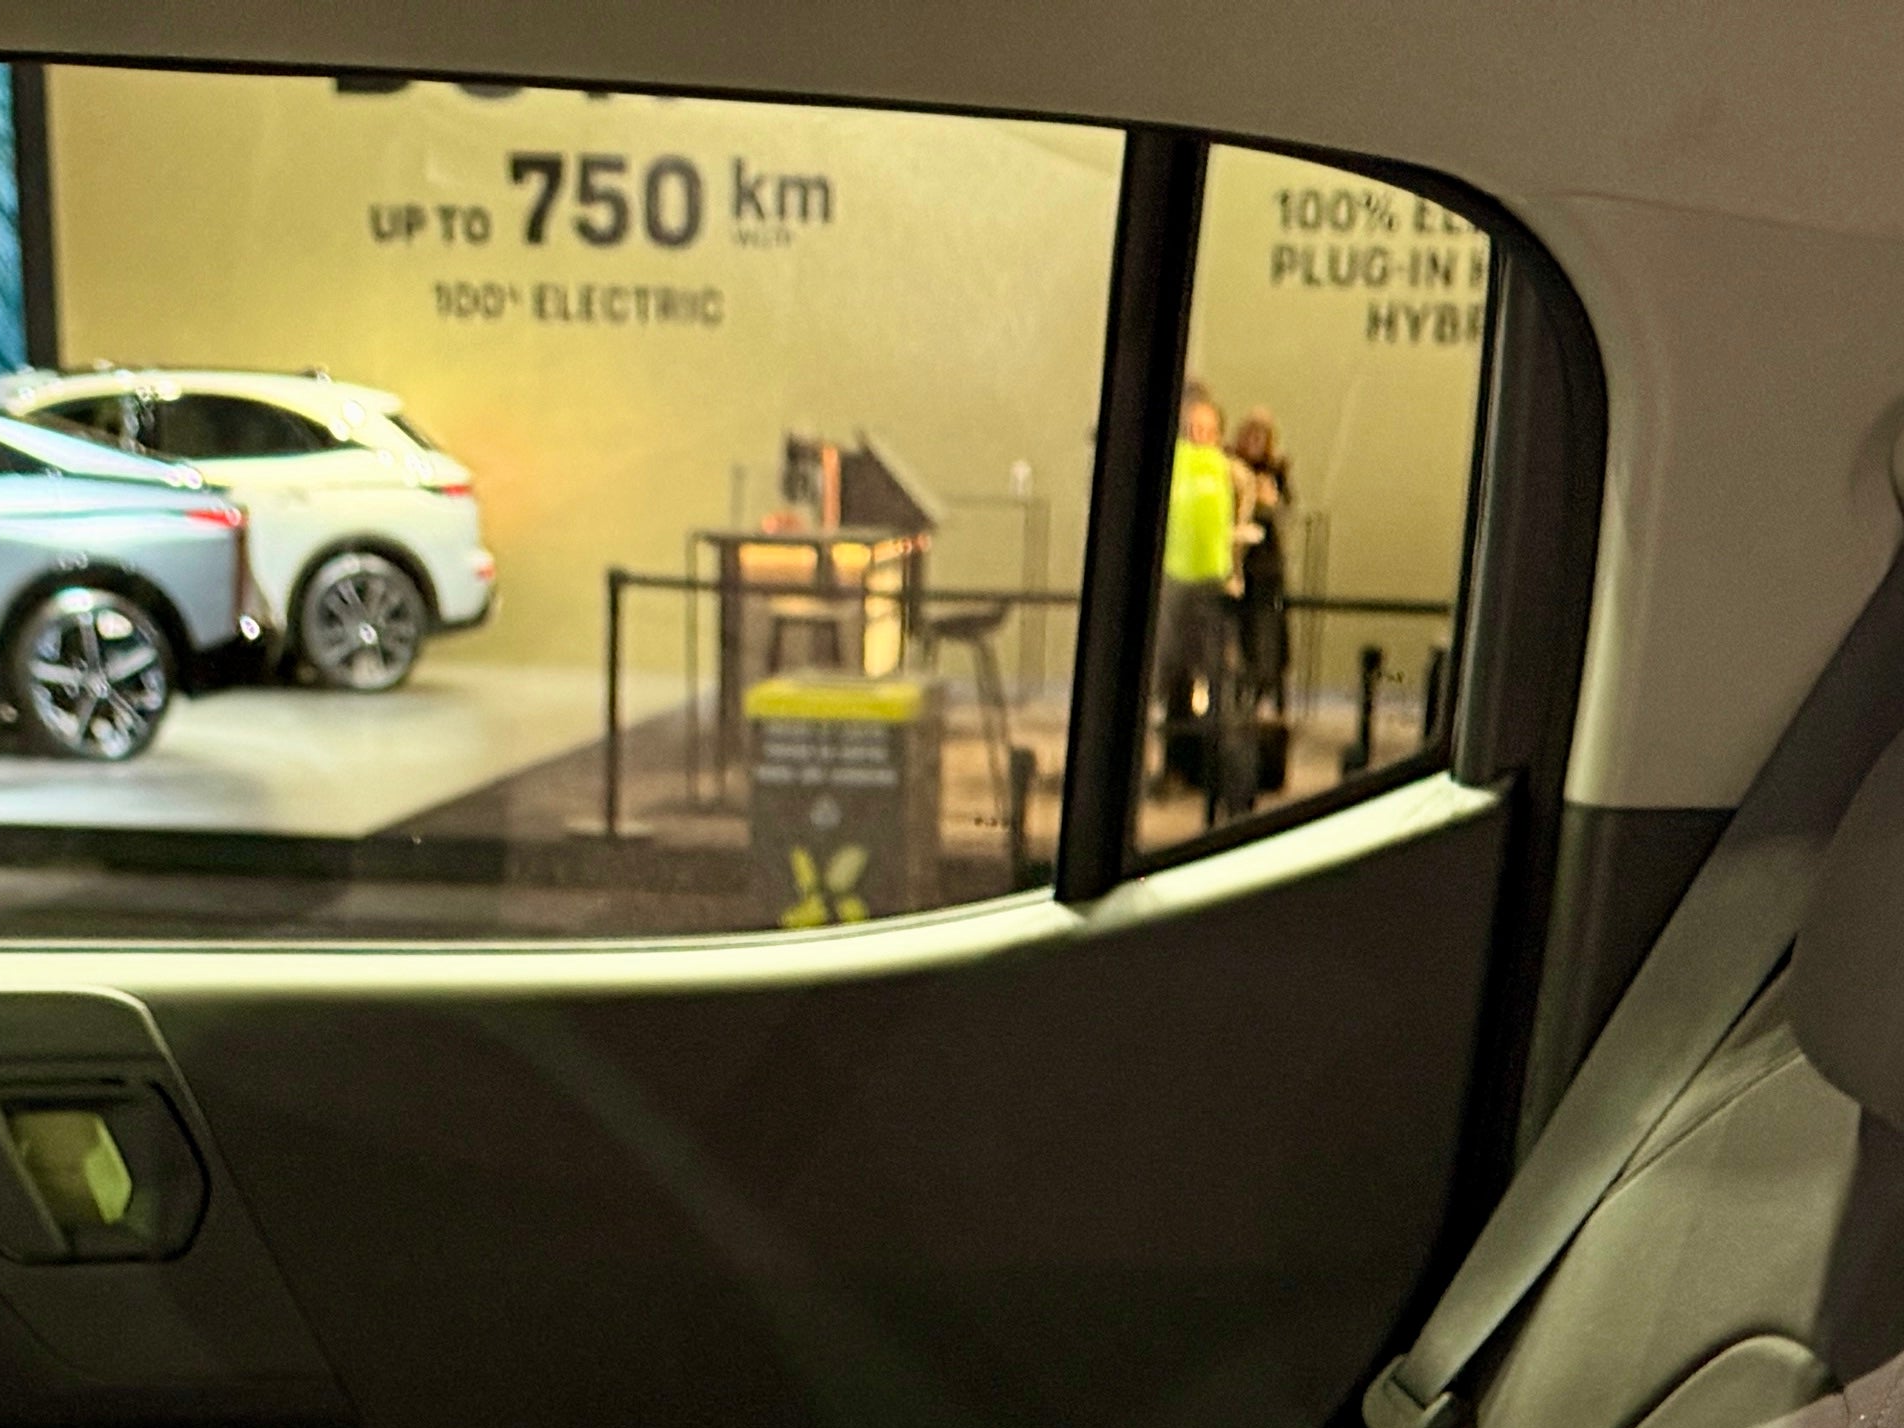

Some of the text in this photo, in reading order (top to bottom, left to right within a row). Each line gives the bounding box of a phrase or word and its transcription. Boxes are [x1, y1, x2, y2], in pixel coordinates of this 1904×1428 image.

[369, 150, 834, 248] UP TO 750 km
[1276, 188, 1398, 233] 100%
[530, 282, 725, 327] ELECTRIC
